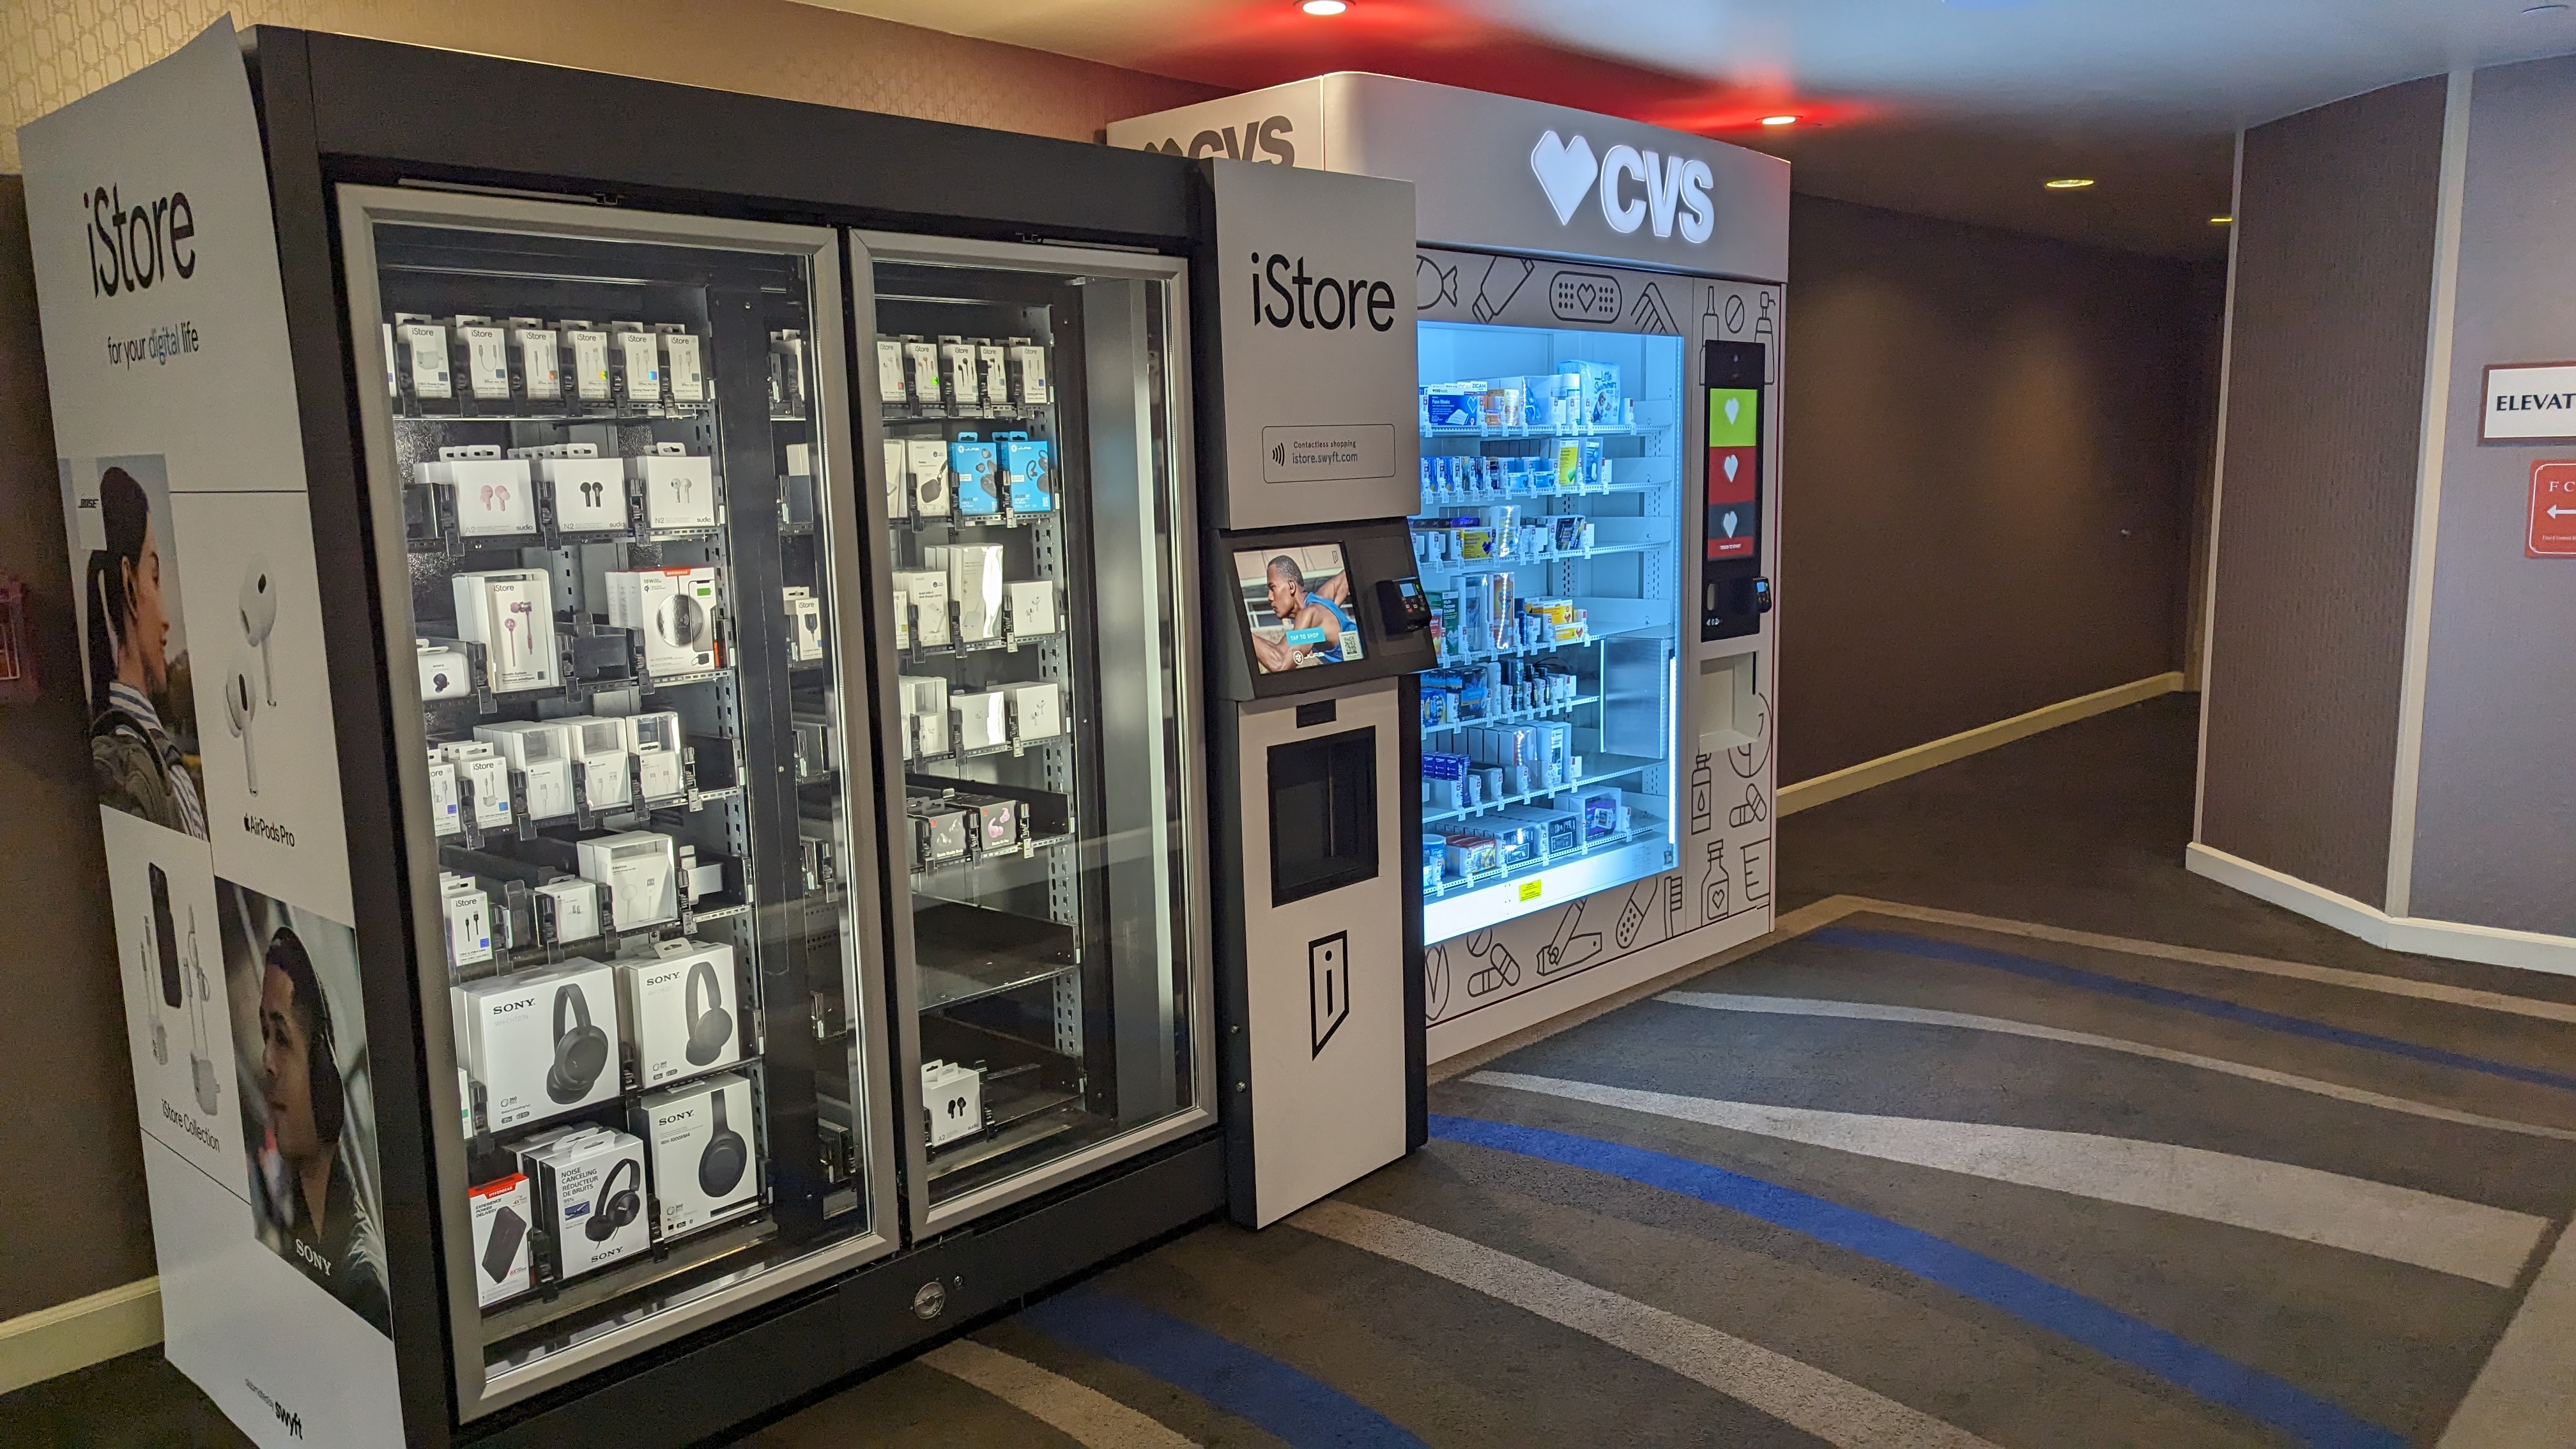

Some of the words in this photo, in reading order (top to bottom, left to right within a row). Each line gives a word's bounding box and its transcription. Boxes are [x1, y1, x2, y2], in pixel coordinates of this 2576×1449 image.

[1600, 144, 1715, 243] CVS
[84, 182, 195, 298] iStore
[1251, 252, 1395, 332] iStore
[411, 327, 434, 336] iStore
[471, 329, 493, 338] iStore
[526, 332, 546, 340] iStore
[577, 333, 597, 342] iStore
[627, 334, 647, 343] iStore
[107, 335, 122, 365] for
[123, 337, 146, 371] your
[148, 324, 180, 365] digital
[181, 321, 199, 353] life
[2496, 393, 2576, 411] ELEVAT
[1330, 440, 1356, 448] shopping
[1292, 451, 1358, 465] istore.swyft.com
[493, 583, 514, 593] iStore
[473, 762, 494, 770] iStore
[250, 815, 280, 843] AirPods
[280, 825, 295, 847] Pro
[456, 899, 477, 907] iStore
[646, 972, 680, 986] SONY
[493, 998, 535, 1015] SONY
[659, 1110, 694, 1126] SONY
[161, 1098, 183, 1128] iStore
[183, 1114, 220, 1153] Collection
[661, 1133, 691, 1146] WH-1000XM4
[561, 1167, 581, 1179] NOISE
[562, 1169, 597, 1184] CANCELING
[562, 1176, 599, 1192] RÉDUCTEUR
[572, 1183, 594, 1195] BRUITS
[475, 1206, 493, 1214] POWER
[295, 1238, 332, 1276] SONY
[591, 1246, 624, 1263] SONY
[275, 1401, 303, 1441] swyft
